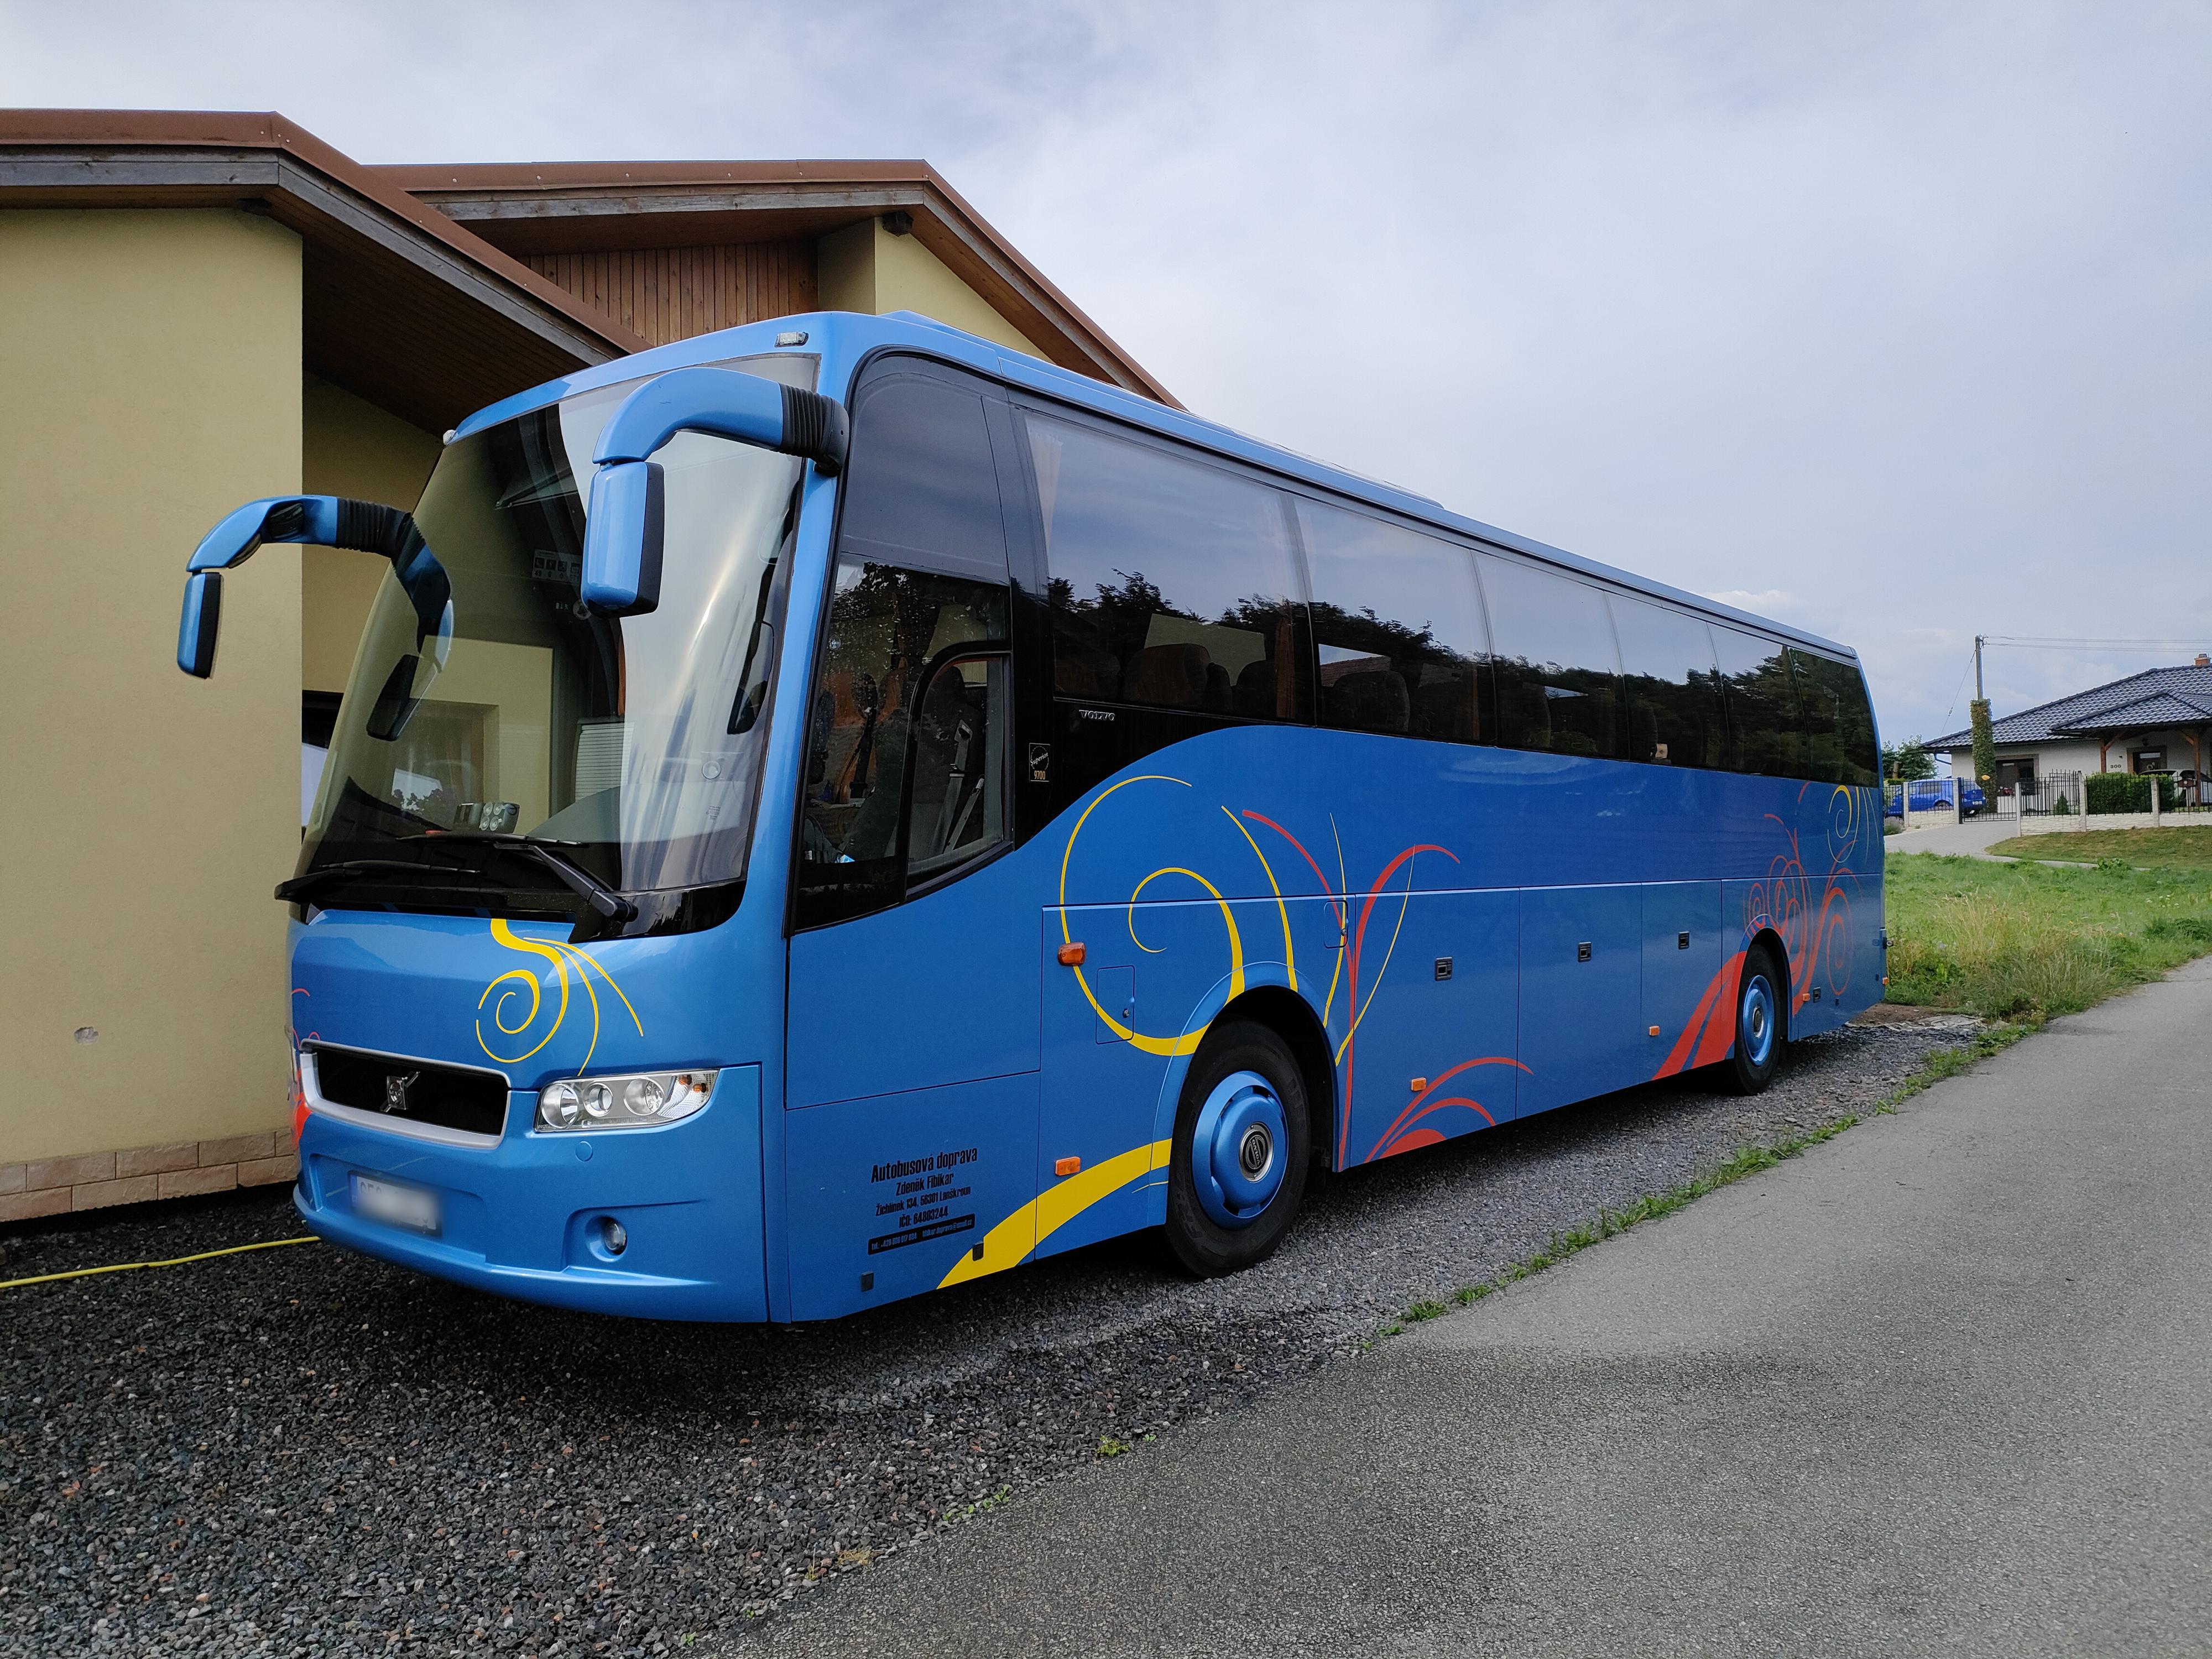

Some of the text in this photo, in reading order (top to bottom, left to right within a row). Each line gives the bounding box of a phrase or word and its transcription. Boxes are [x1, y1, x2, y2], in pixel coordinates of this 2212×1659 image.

[1078, 709, 1115, 722] VOLVO
[1030, 752, 1049, 766] Superior
[1034, 770, 1046, 780] 9700
[1251, 1139, 1260, 1166] VOLVO
[871, 1147, 978, 1183] Autobusová doprava
[896, 1173, 954, 1196] Zdeněk Fibikar
[906, 1196, 919, 1209] 134,
[920, 1192, 938, 1206] 56301
[940, 1186, 971, 1202] Lanškroun
[899, 1206, 948, 1228] IČO: 64803244
